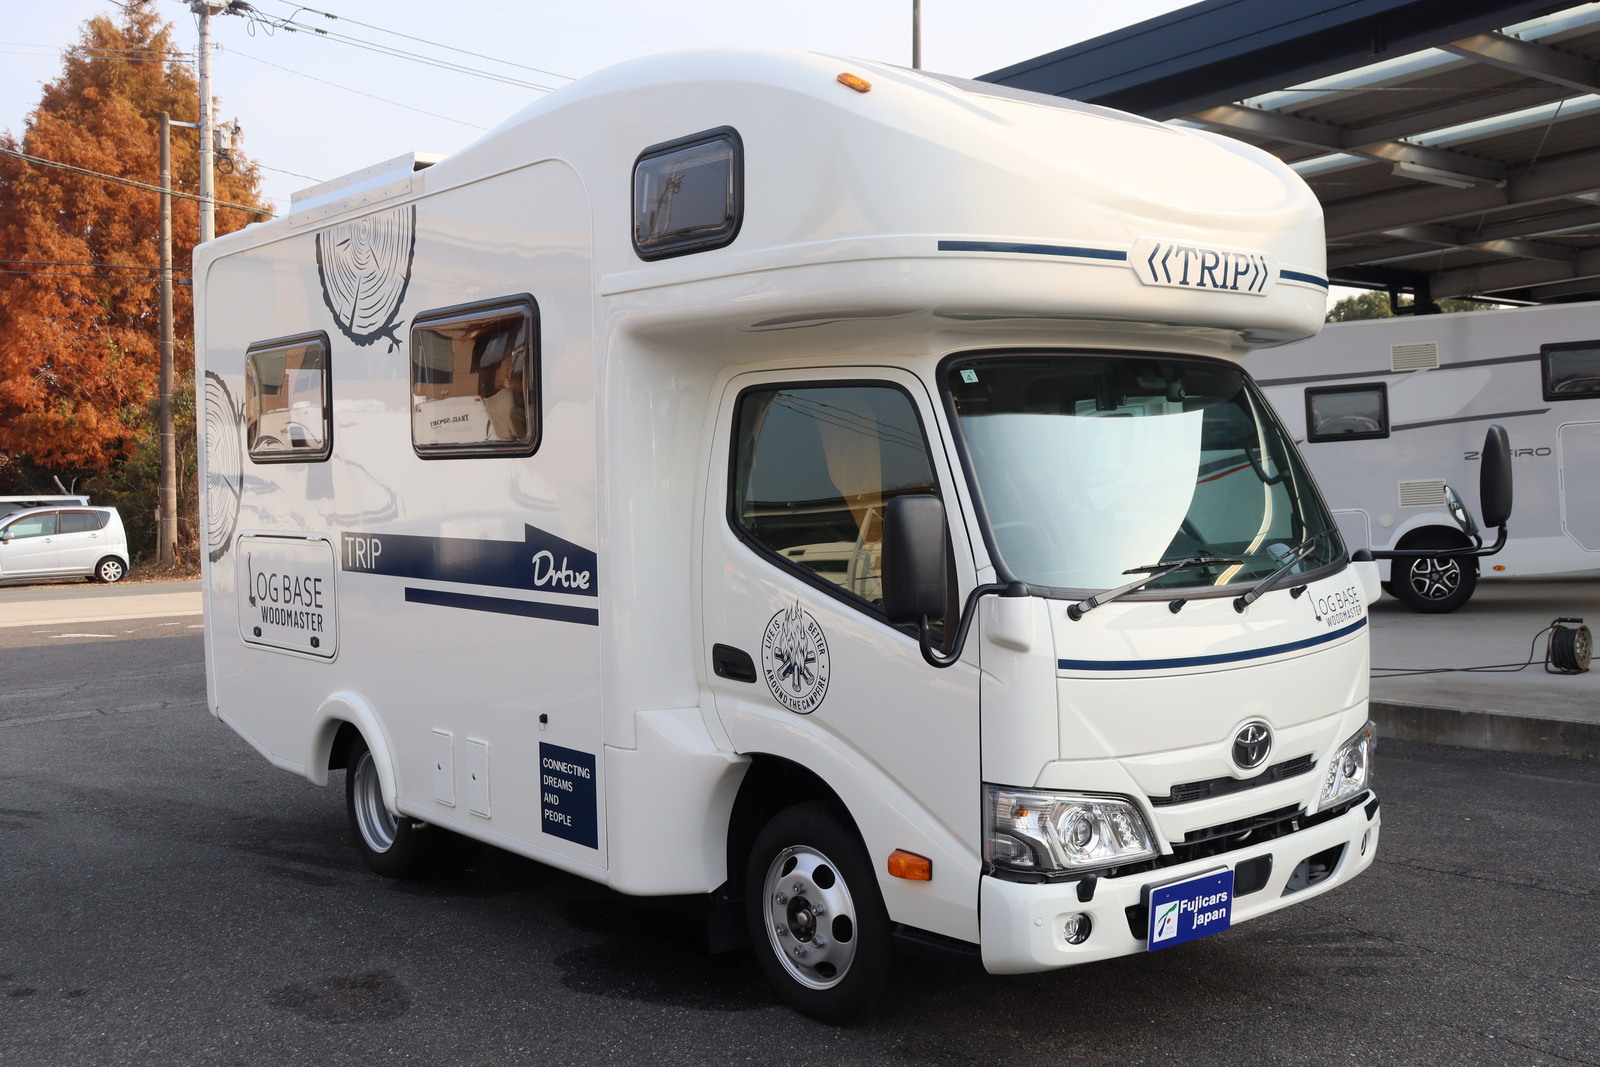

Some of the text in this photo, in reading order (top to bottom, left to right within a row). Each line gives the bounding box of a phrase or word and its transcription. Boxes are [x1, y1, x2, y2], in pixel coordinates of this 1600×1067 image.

[1175, 245, 1250, 290] TRIP
[1464, 447, 1551, 460] ZIRO
[345, 536, 382, 569] TRIP
[283, 575, 323, 609] BASE
[1335, 586, 1359, 609] BASE
[261, 606, 324, 632] WOODMASTER
[1326, 605, 1362, 627] WOODMASTER
[765, 620, 826, 655] LIFE IS BETTER
[766, 669, 826, 710] AROUND THE CAMPFIRE
[542, 757, 590, 779] CONNECTING
[543, 774, 573, 792] DREAMS
[543, 792, 559, 805] AND
[544, 808, 572, 826] PEOPLE
[1180, 891, 1228, 914] Fujicars
[1192, 907, 1226, 929] japan
